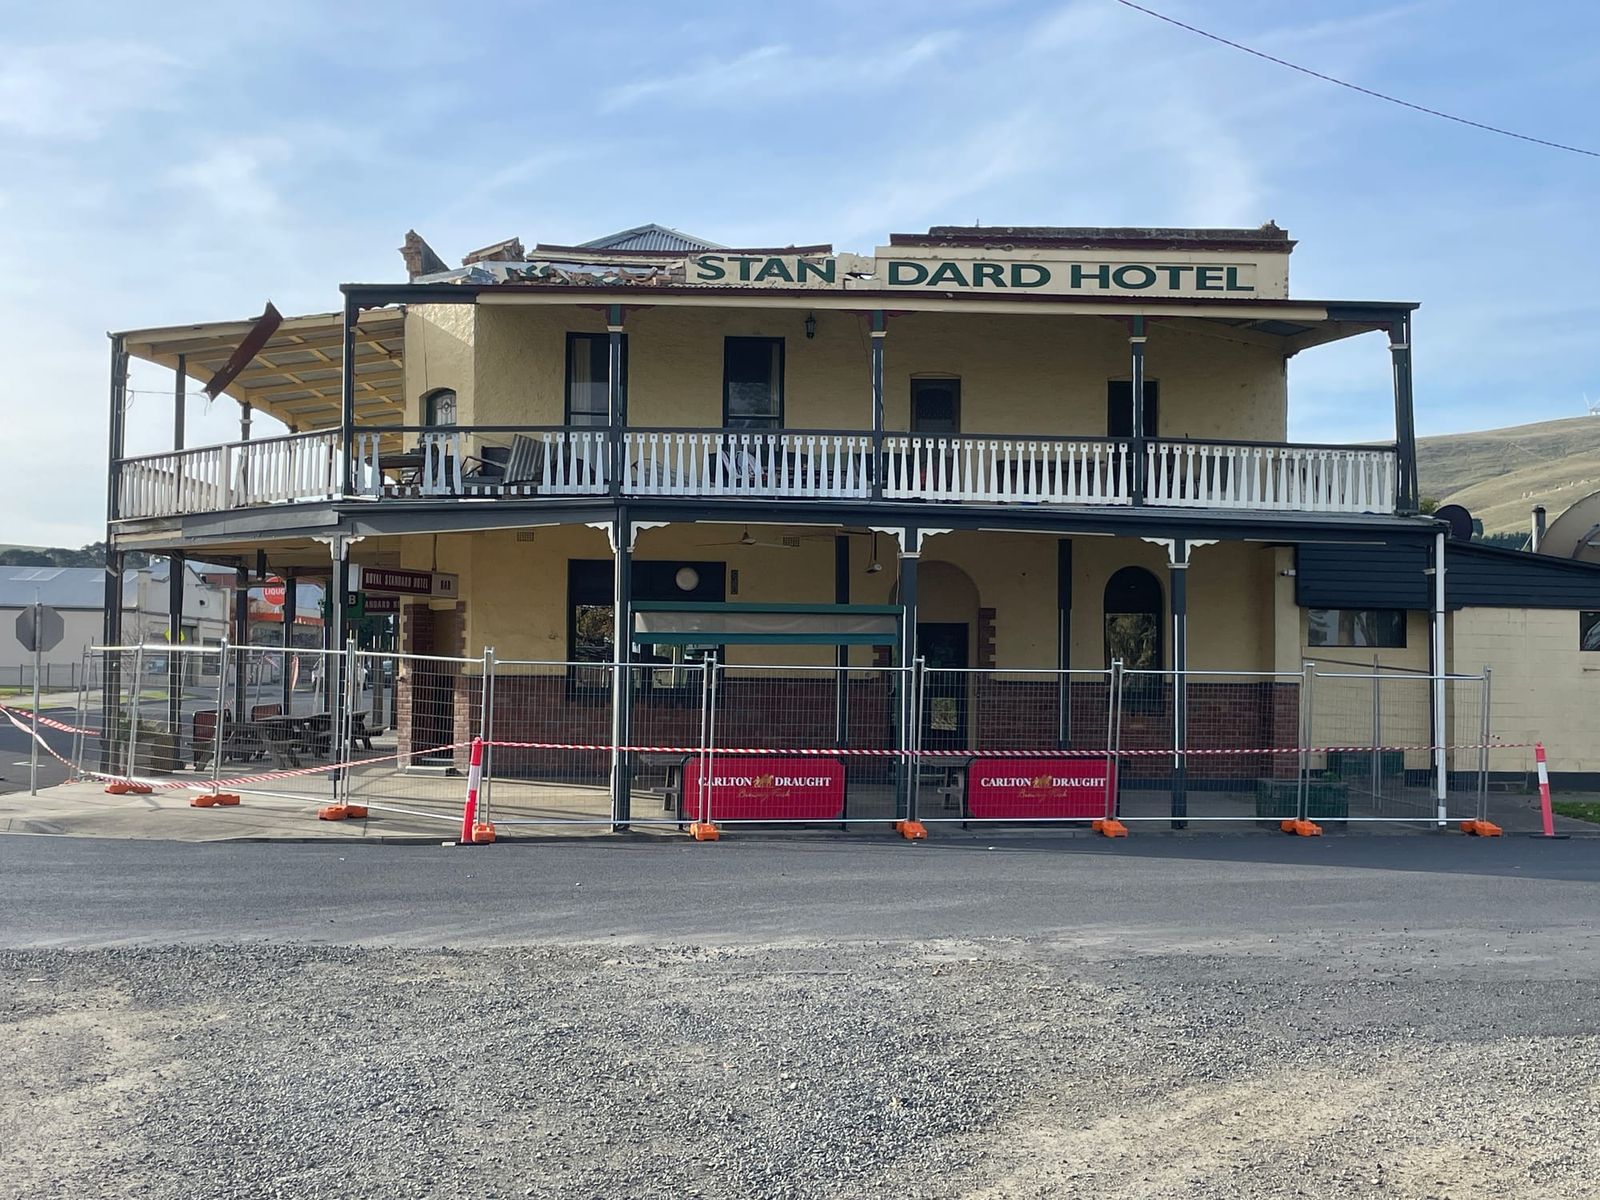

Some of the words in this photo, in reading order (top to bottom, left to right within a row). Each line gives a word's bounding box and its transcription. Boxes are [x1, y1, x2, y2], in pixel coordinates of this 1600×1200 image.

[696, 255, 836, 284] STAN
[888, 261, 1051, 288] DARD
[1070, 264, 1255, 292] HOTEL
[365, 572, 382, 585] ROYAL
[384, 574, 412, 588] STANDARD
[413, 577, 429, 590] HOTEL
[264, 587, 286, 596] LIQUO
[364, 600, 391, 609] ANDARD
[698, 776, 753, 787] CARLTON
[774, 776, 832, 787] DRAUGHT
[980, 777, 1032, 787] CARLTON
[1052, 777, 1106, 787] DRAUGHT
